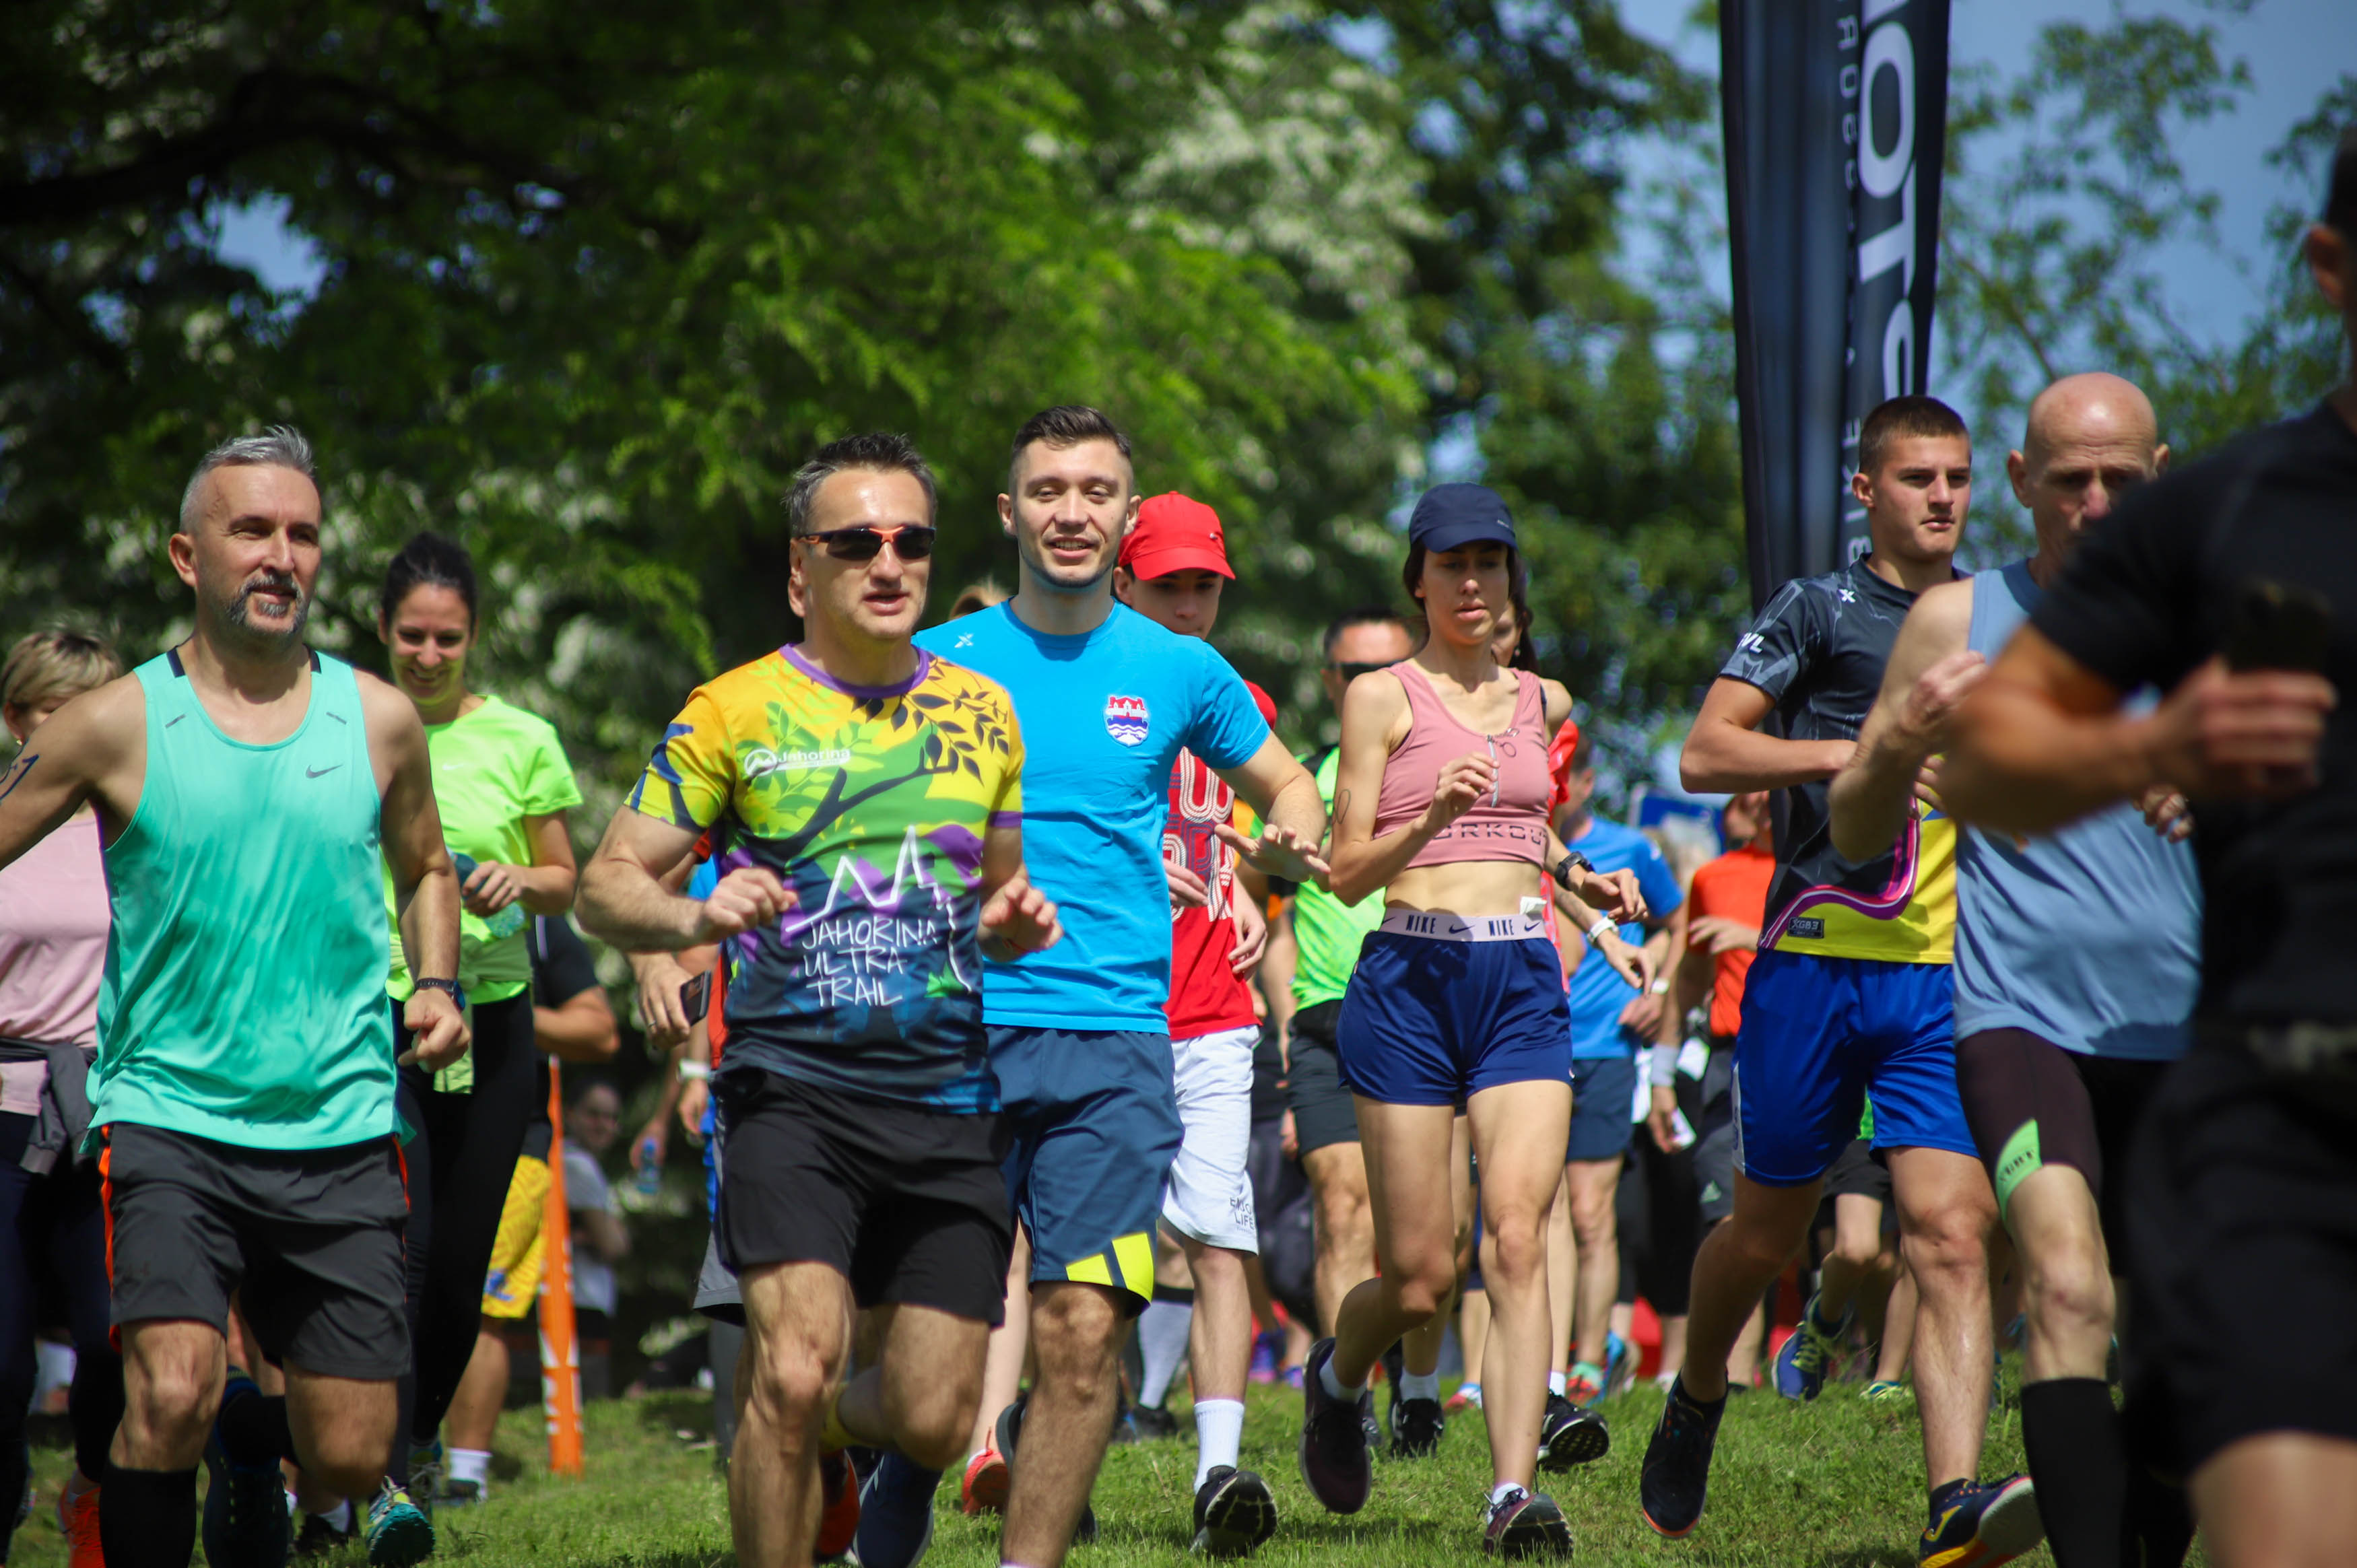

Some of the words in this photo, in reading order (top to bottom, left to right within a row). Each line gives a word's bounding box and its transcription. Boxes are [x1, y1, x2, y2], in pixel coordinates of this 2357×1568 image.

[801, 916, 938, 950] JAHORINA
[1406, 914, 1436, 934] NIKE
[1488, 918, 1515, 936] NIKE
[803, 944, 908, 980] ULTRA
[805, 977, 904, 1007] TRAIL
[1234, 1211, 1255, 1231] LIFE
